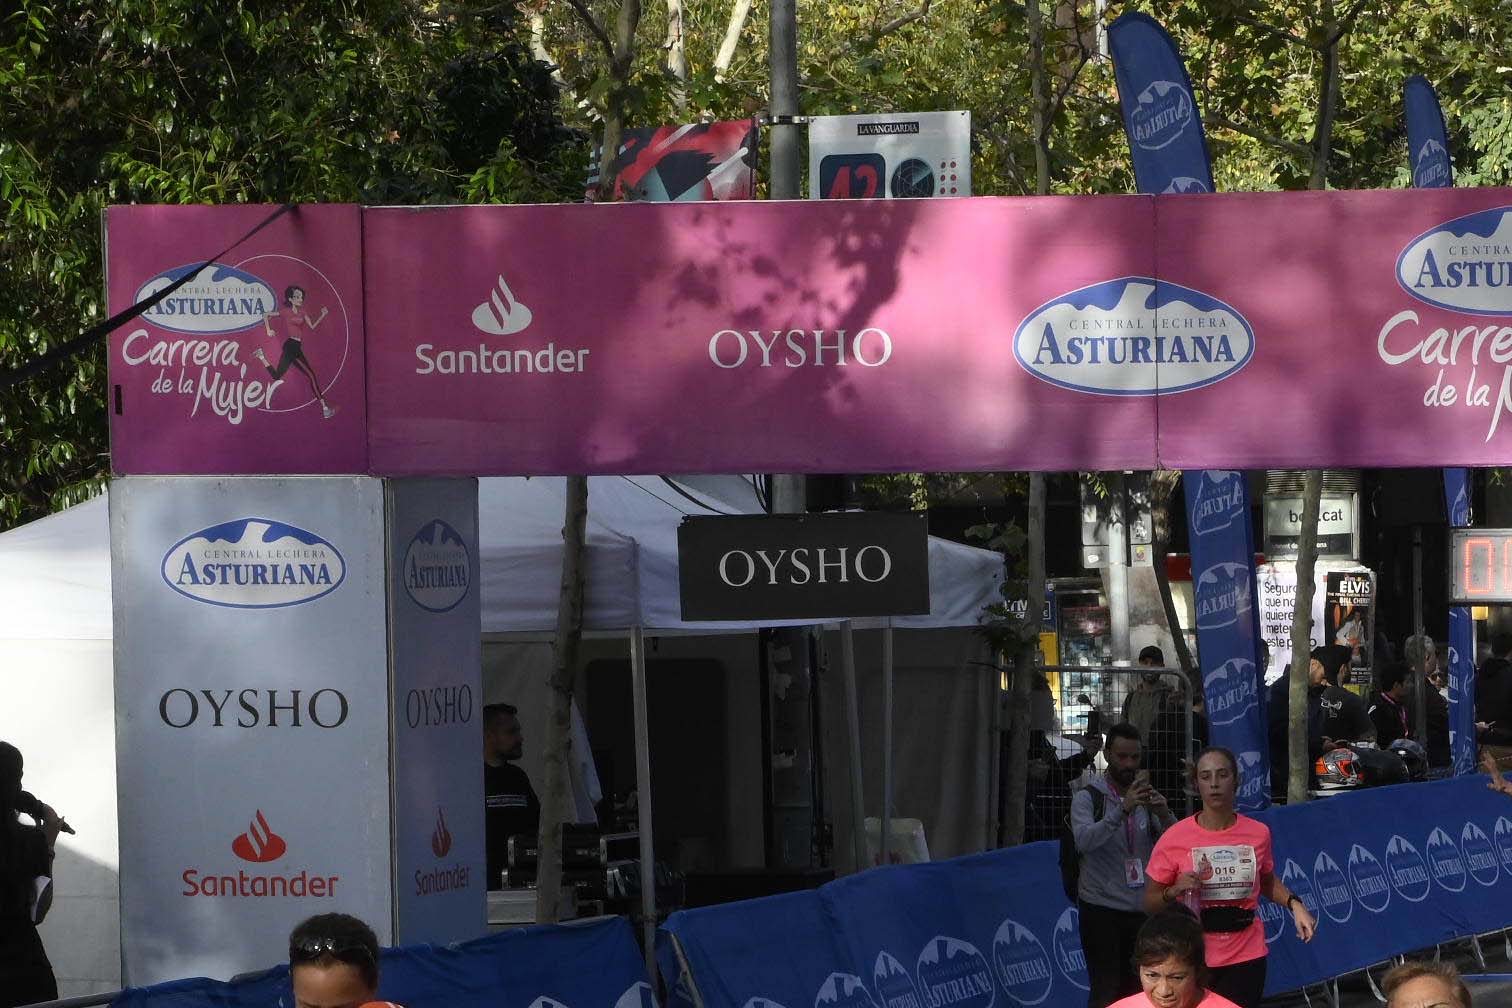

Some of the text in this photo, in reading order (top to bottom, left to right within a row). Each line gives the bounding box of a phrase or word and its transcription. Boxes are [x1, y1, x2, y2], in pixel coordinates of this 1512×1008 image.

[146, 289, 266, 318] ASTURIANA
[1069, 316, 1228, 330] CENTRAL LECHERA
[122, 328, 241, 368] Carrera
[415, 342, 590, 375] Santander
[708, 328, 893, 369] OYSHO
[1033, 321, 1236, 366] ASTURIANA
[151, 360, 285, 425] de la Mujer
[1423, 368, 1458, 408] de
[1465, 368, 1491, 408] la
[176, 552, 333, 586] ASTURIANA
[203, 550, 326, 559] CENTRAL LECHERA
[407, 553, 468, 590] ASTURIANA
[719, 545, 892, 587] OYSHO
[1265, 598, 1281, 611] que
[1340, 580, 1370, 594] ELVIS
[159, 688, 349, 730] OYSHO
[405, 683, 472, 729] OYSHO
[182, 868, 339, 899] Santander
[414, 862, 471, 898] Santander
[1215, 866, 1235, 875] 016
